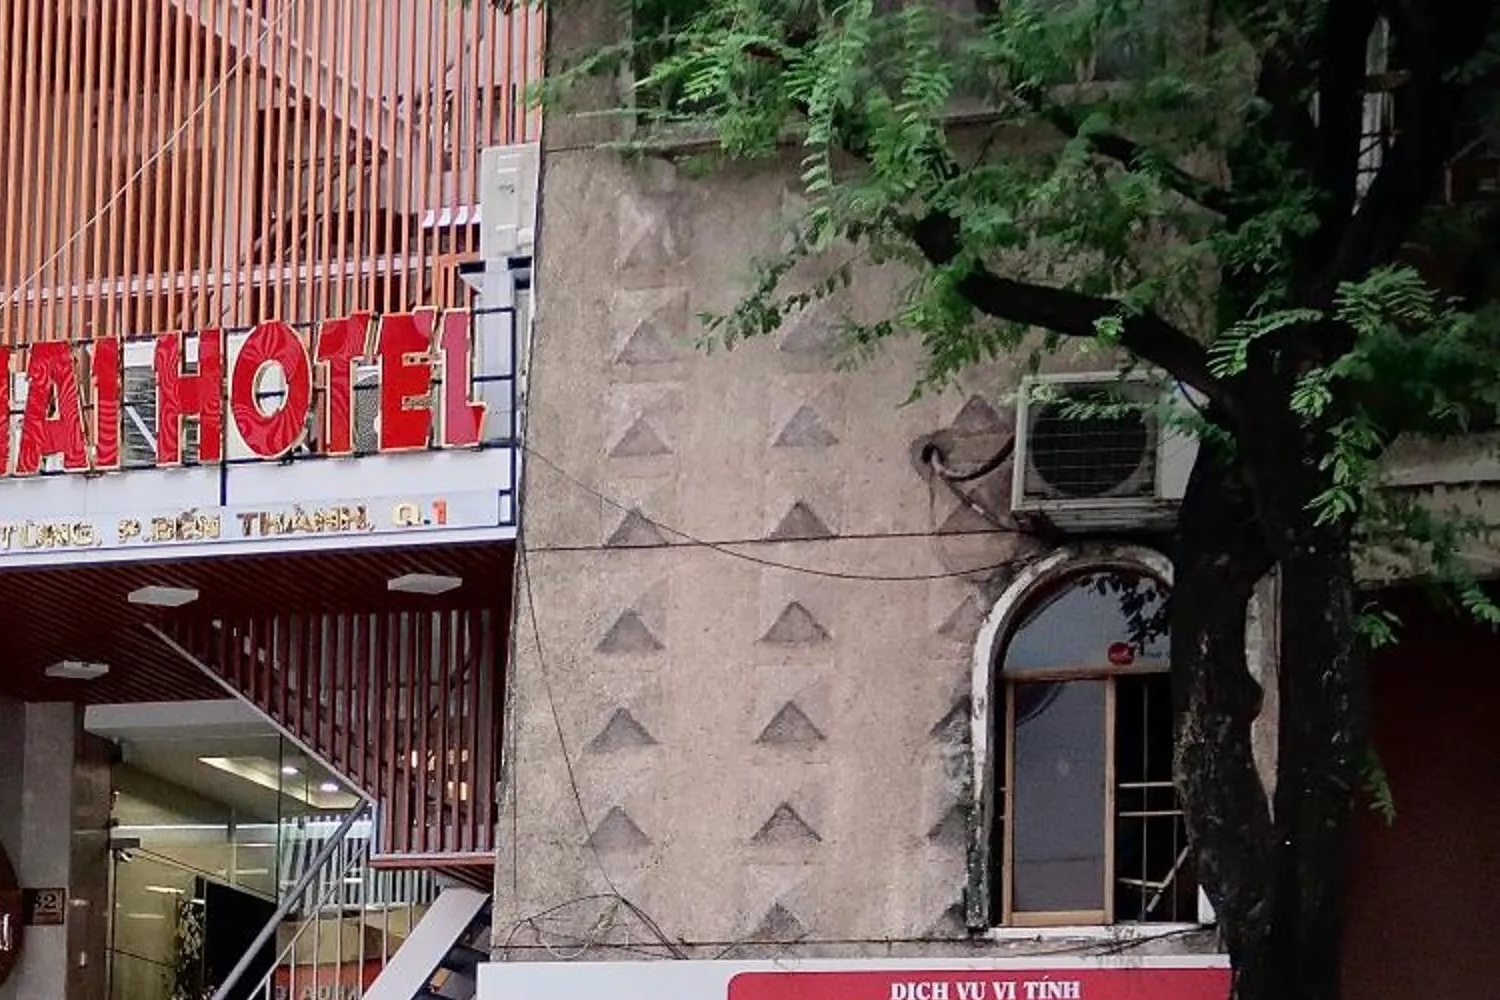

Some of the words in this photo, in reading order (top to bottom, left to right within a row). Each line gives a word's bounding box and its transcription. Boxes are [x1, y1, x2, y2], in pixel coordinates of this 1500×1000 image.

[154, 306, 486, 467] HOTEL
[994, 981, 1017, 1000] VI
[1024, 976, 1081, 1000] TÍNH
